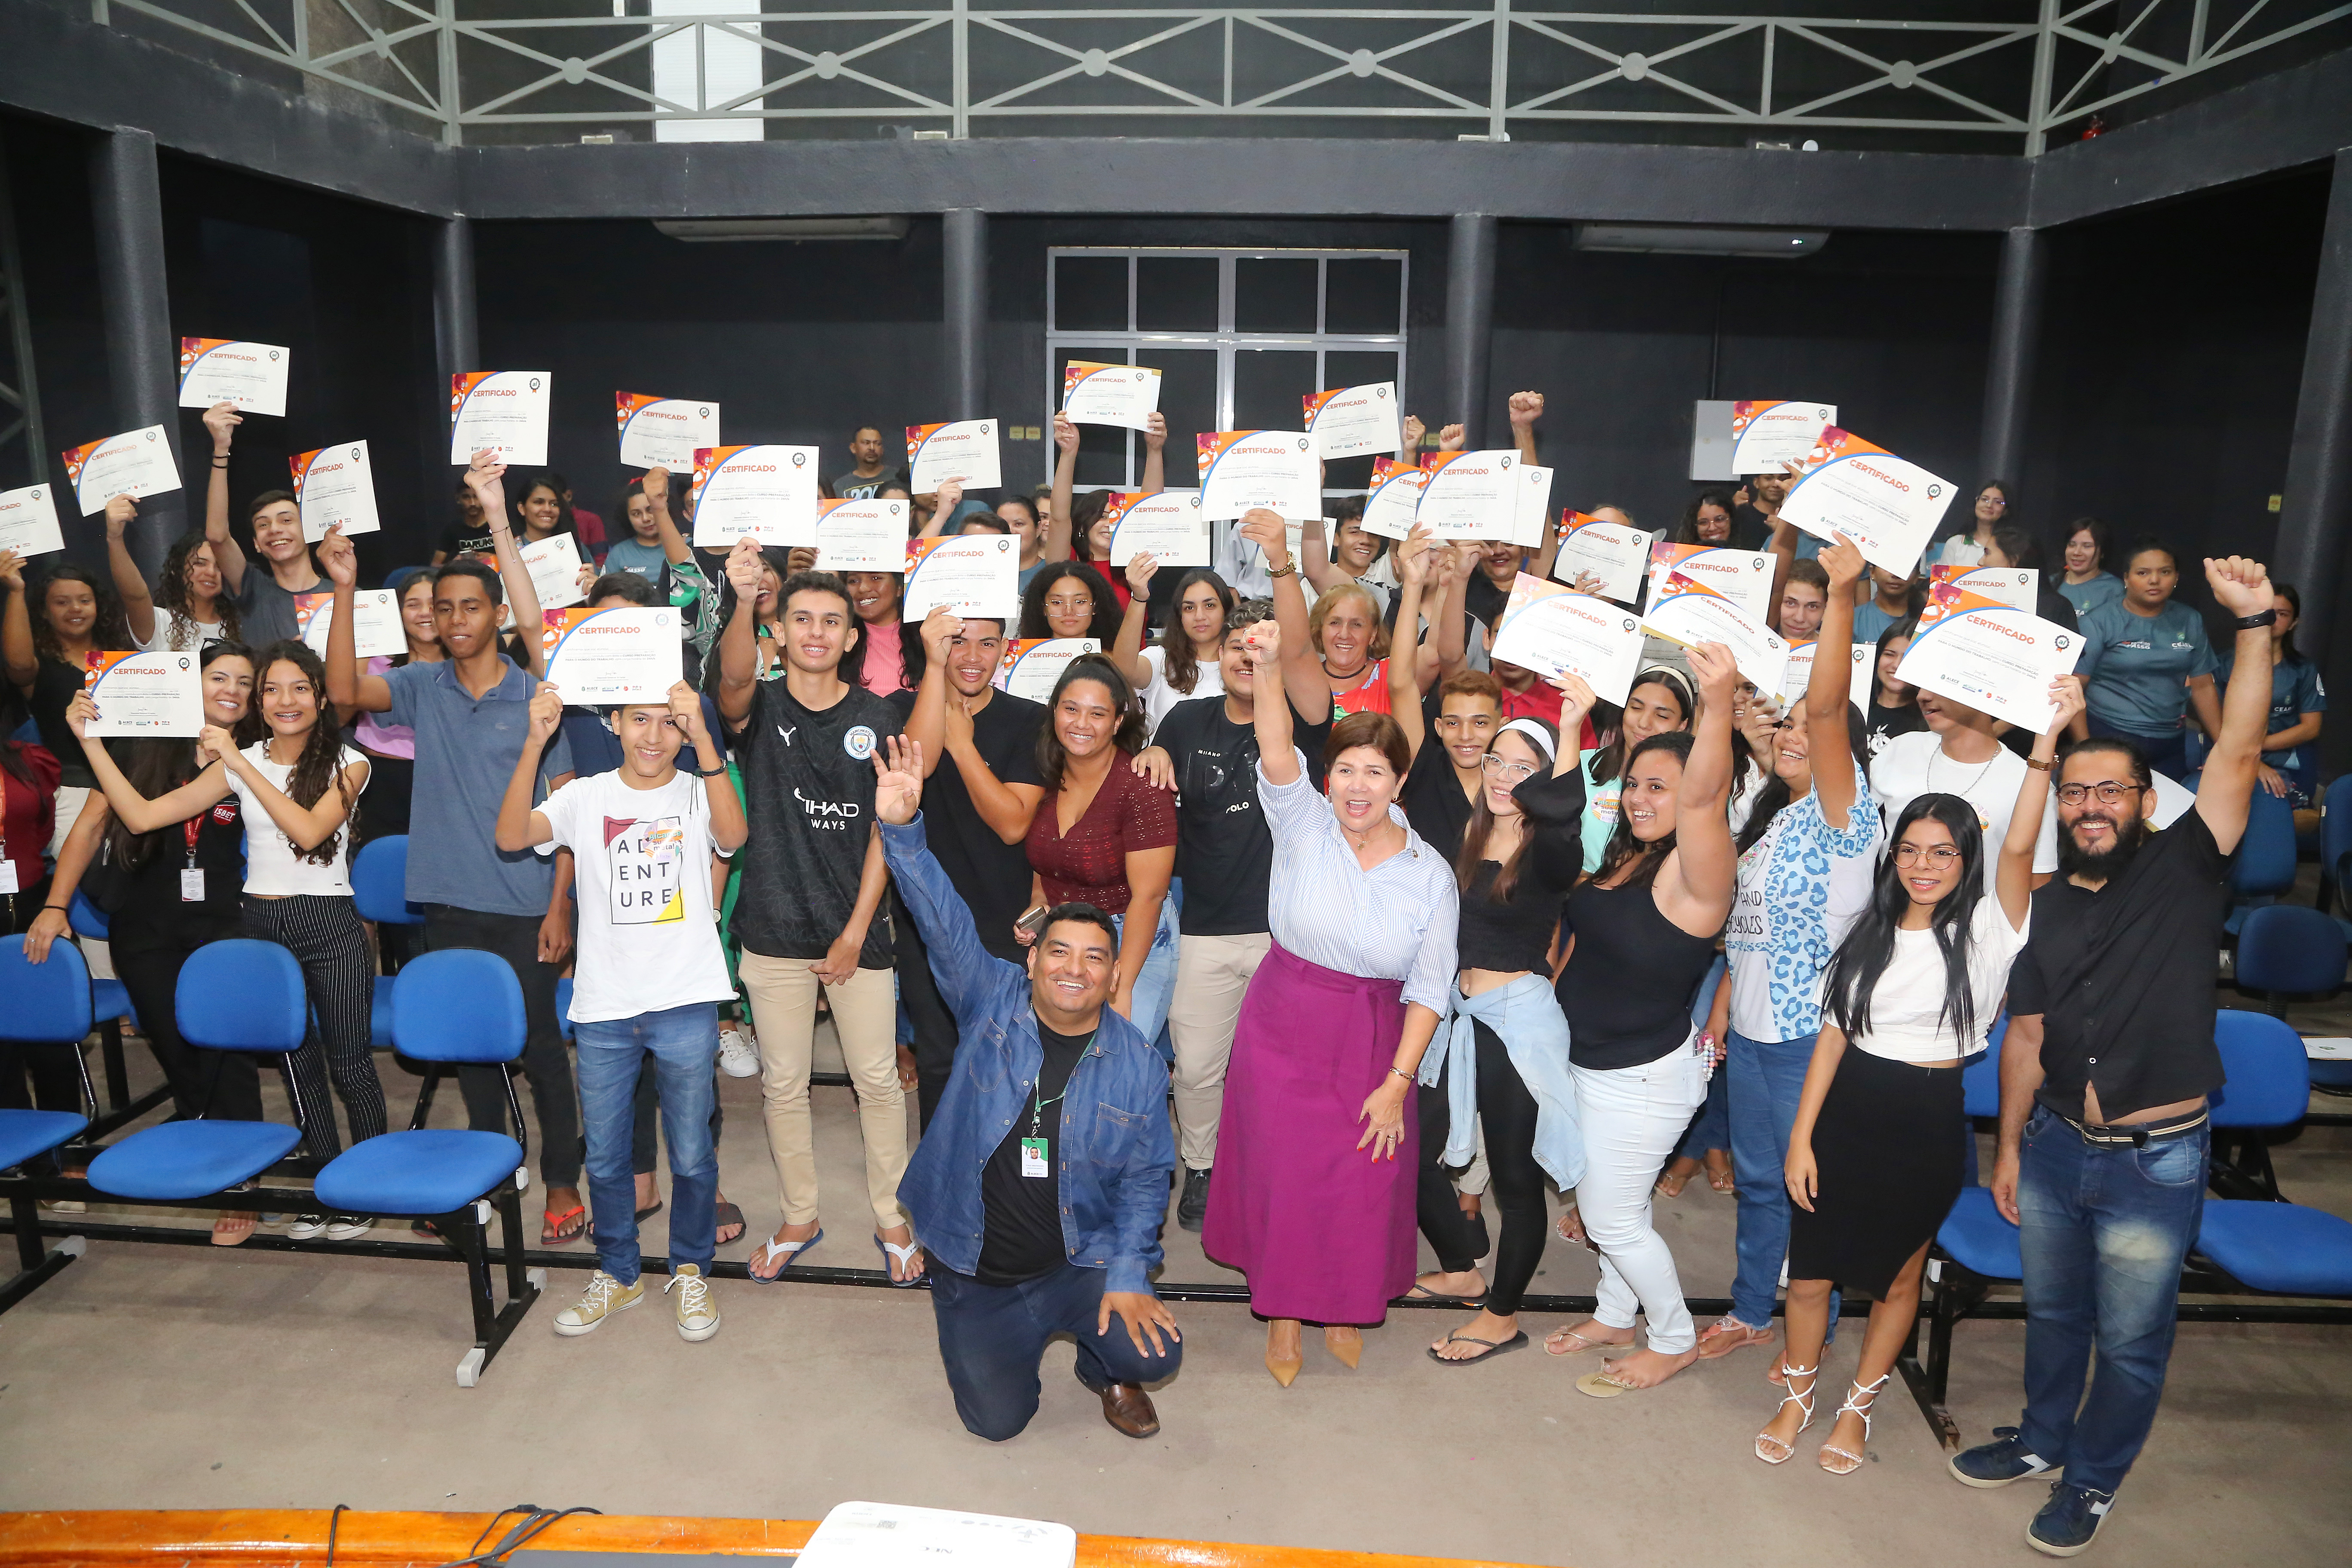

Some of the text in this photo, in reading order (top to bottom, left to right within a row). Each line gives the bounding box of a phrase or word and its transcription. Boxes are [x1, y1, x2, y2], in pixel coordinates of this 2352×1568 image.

[210, 353, 257, 362] CERTIFICADO
[1326, 399, 1367, 410] CERTIFICADO
[642, 411, 687, 421] CERTIFICADO
[930, 435, 970, 443] CERTIFICADO
[92, 444, 137, 460] CERTIFICADO
[310, 463, 343, 476] CERTIFICADO
[1850, 459, 1909, 492] CERTIFICADO
[1580, 529, 1620, 545] CERTIFICADO
[1684, 562, 1739, 573] CERTIFICADO
[1547, 600, 1607, 627] CERTIFICADO
[1700, 597, 1755, 634] CERTIFICADO
[1966, 614, 2035, 645] CERTIFICADO
[849, 729, 873, 738] MANCHESTER
[214, 808, 236, 819] ISBET
[811, 819, 846, 830] WAYS
[1741, 891, 1762, 907] AND
